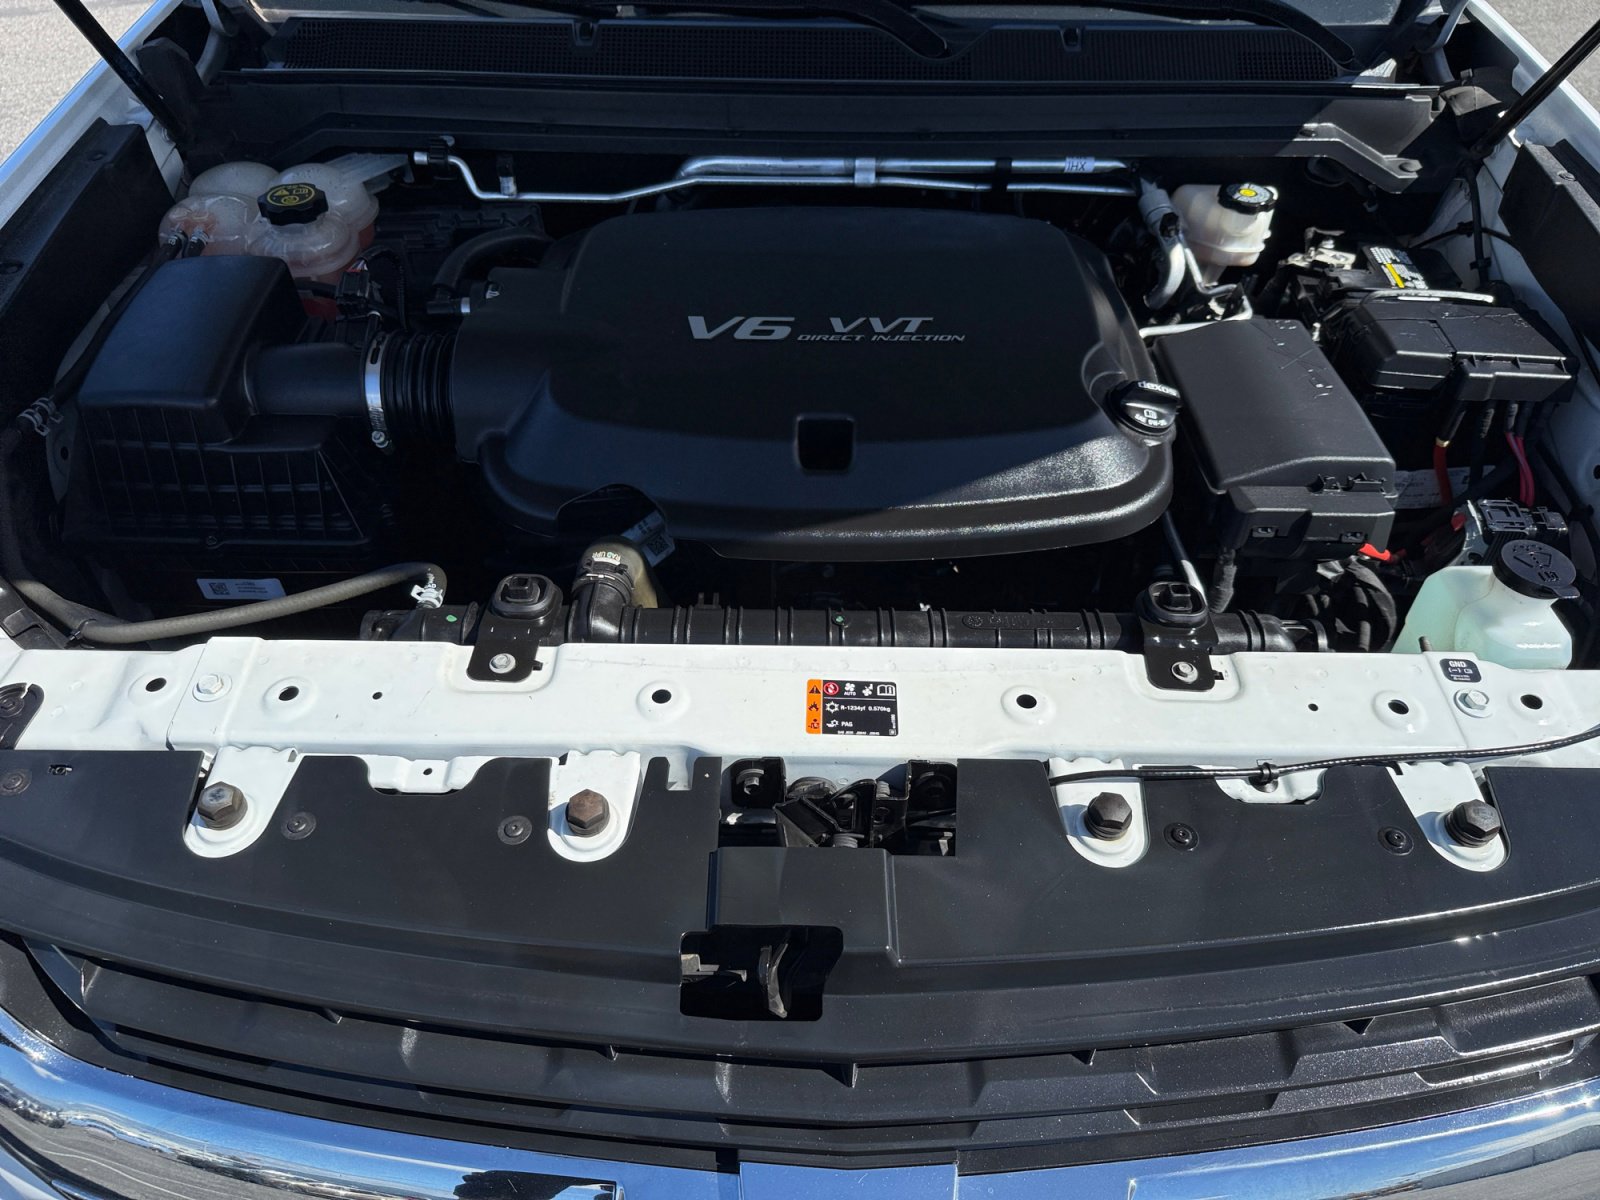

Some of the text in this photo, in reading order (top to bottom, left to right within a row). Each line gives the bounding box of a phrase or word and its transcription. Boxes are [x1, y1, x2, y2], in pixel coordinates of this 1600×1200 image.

[688, 315, 934, 340] V6 VVT
[797, 334, 966, 342] DIRECT INJECTION
[1449, 660, 1467, 668] GND
[840, 704, 866, 712] R-1234yf
